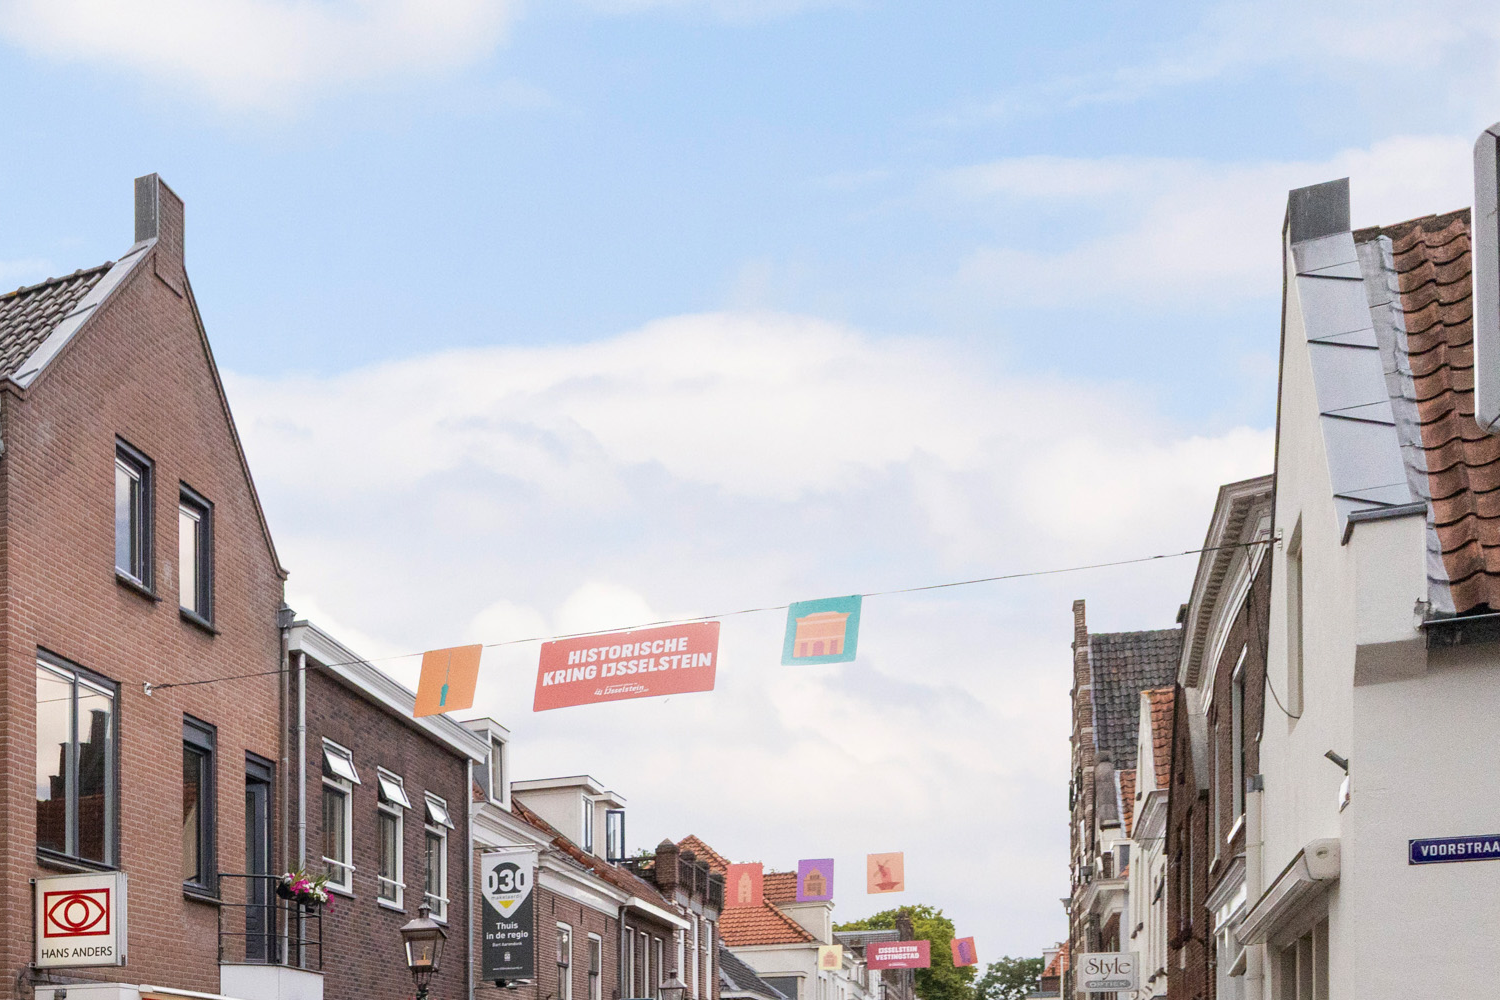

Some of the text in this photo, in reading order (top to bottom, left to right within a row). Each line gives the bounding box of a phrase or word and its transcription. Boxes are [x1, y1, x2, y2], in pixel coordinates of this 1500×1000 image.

[568, 637, 689, 665] HISTORISCHE
[542, 652, 713, 687] KRING IJSSELSTEIN
[1421, 841, 1500, 857] VOORSTRAA
[496, 922, 519, 930] Thuis
[486, 930, 529, 940] in de regio
[41, 946, 113, 959] HANS ANDERS
[875, 952, 920, 961] VESTINGSTAD
[1085, 957, 1131, 981] Style
